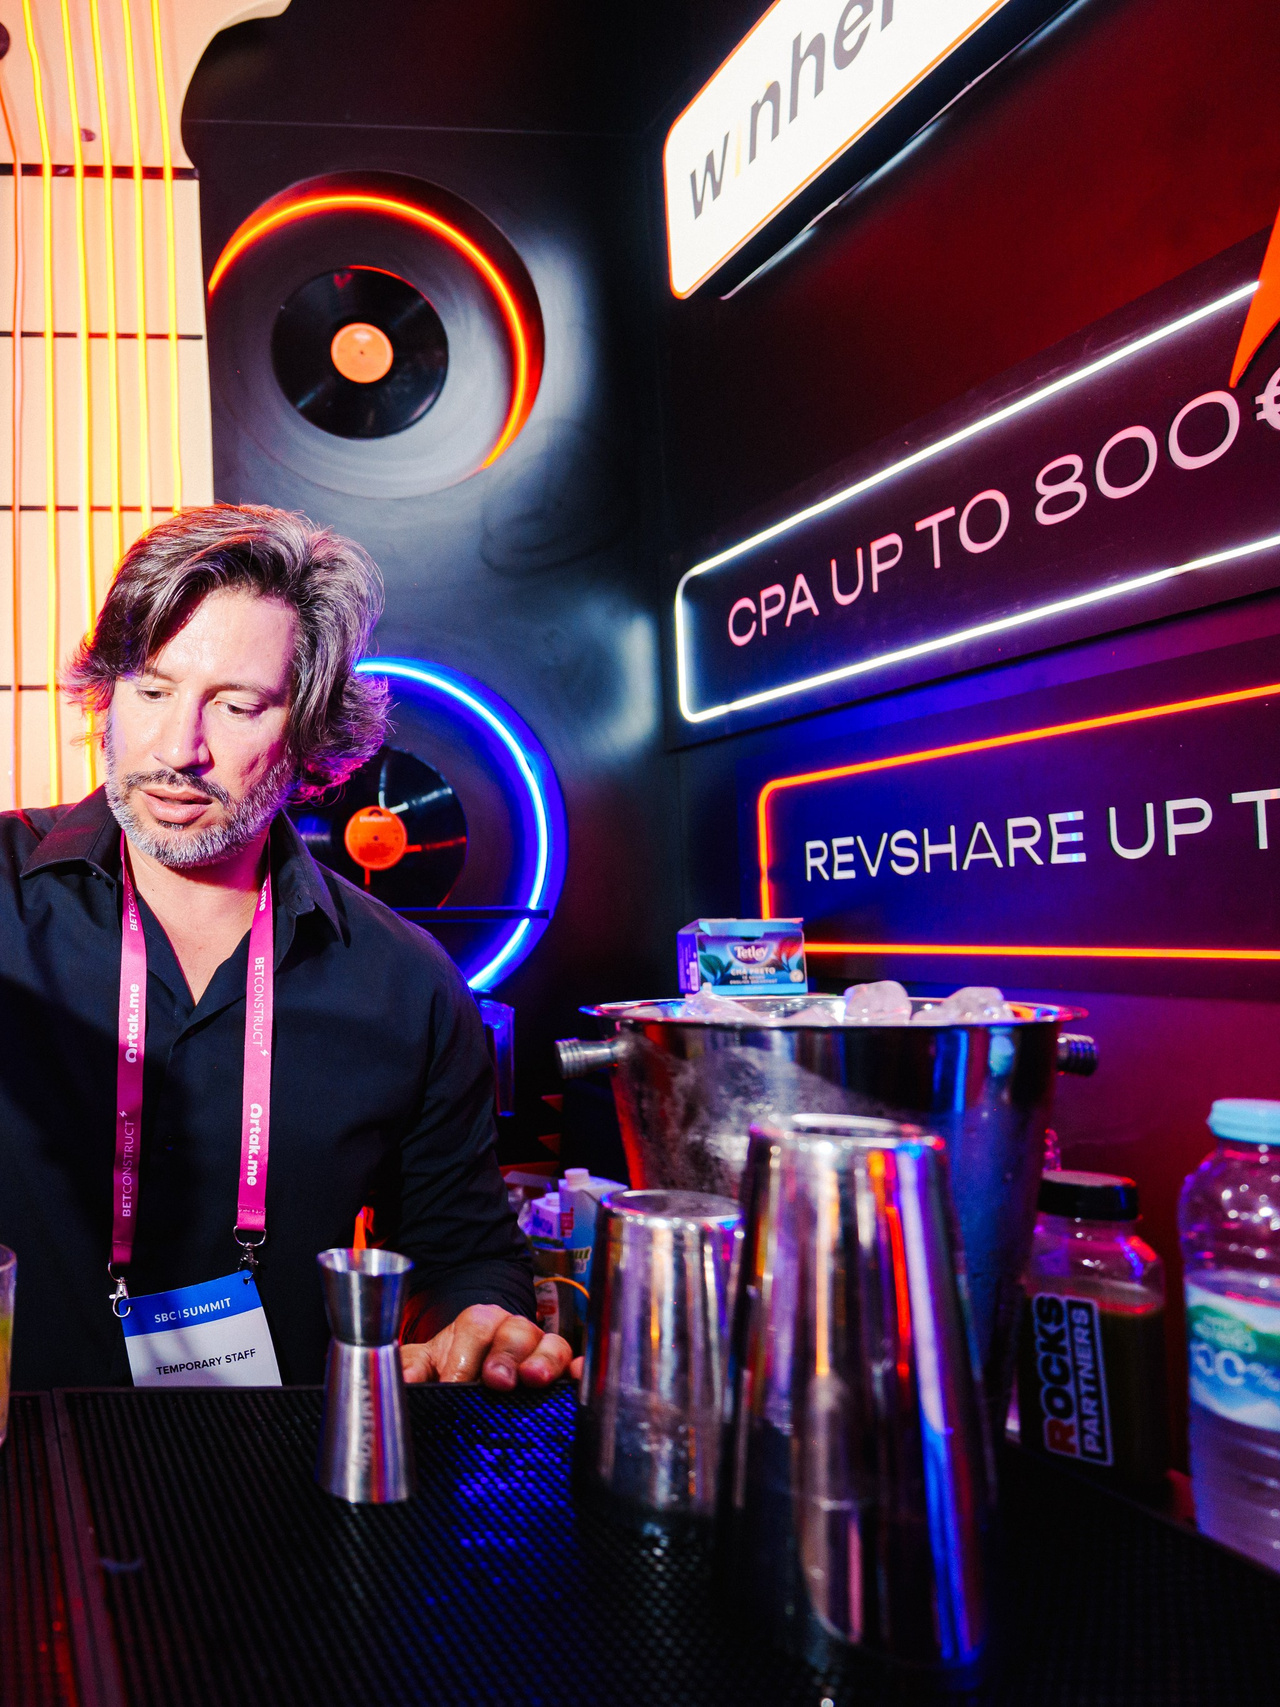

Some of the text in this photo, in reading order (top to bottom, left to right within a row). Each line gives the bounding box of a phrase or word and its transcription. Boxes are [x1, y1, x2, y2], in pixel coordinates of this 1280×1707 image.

[728, 573, 819, 647] CPA
[830, 532, 903, 606] UP
[914, 488, 1010, 569] TO
[805, 810, 1087, 882] REVSHARE
[1108, 797, 1213, 860] UP
[734, 945, 768, 961] Tetley
[252, 957, 265, 1047] BETCONSTRUCT
[122, 1120, 134, 1217] BETCONSTRUCT
[154, 1298, 231, 1323] SBC SUMMIT
[156, 1348, 256, 1375] TEMPORARY STAFF
[1036, 1296, 1078, 1455] ROCKS
[1071, 1307, 1103, 1453] PARTNERS
